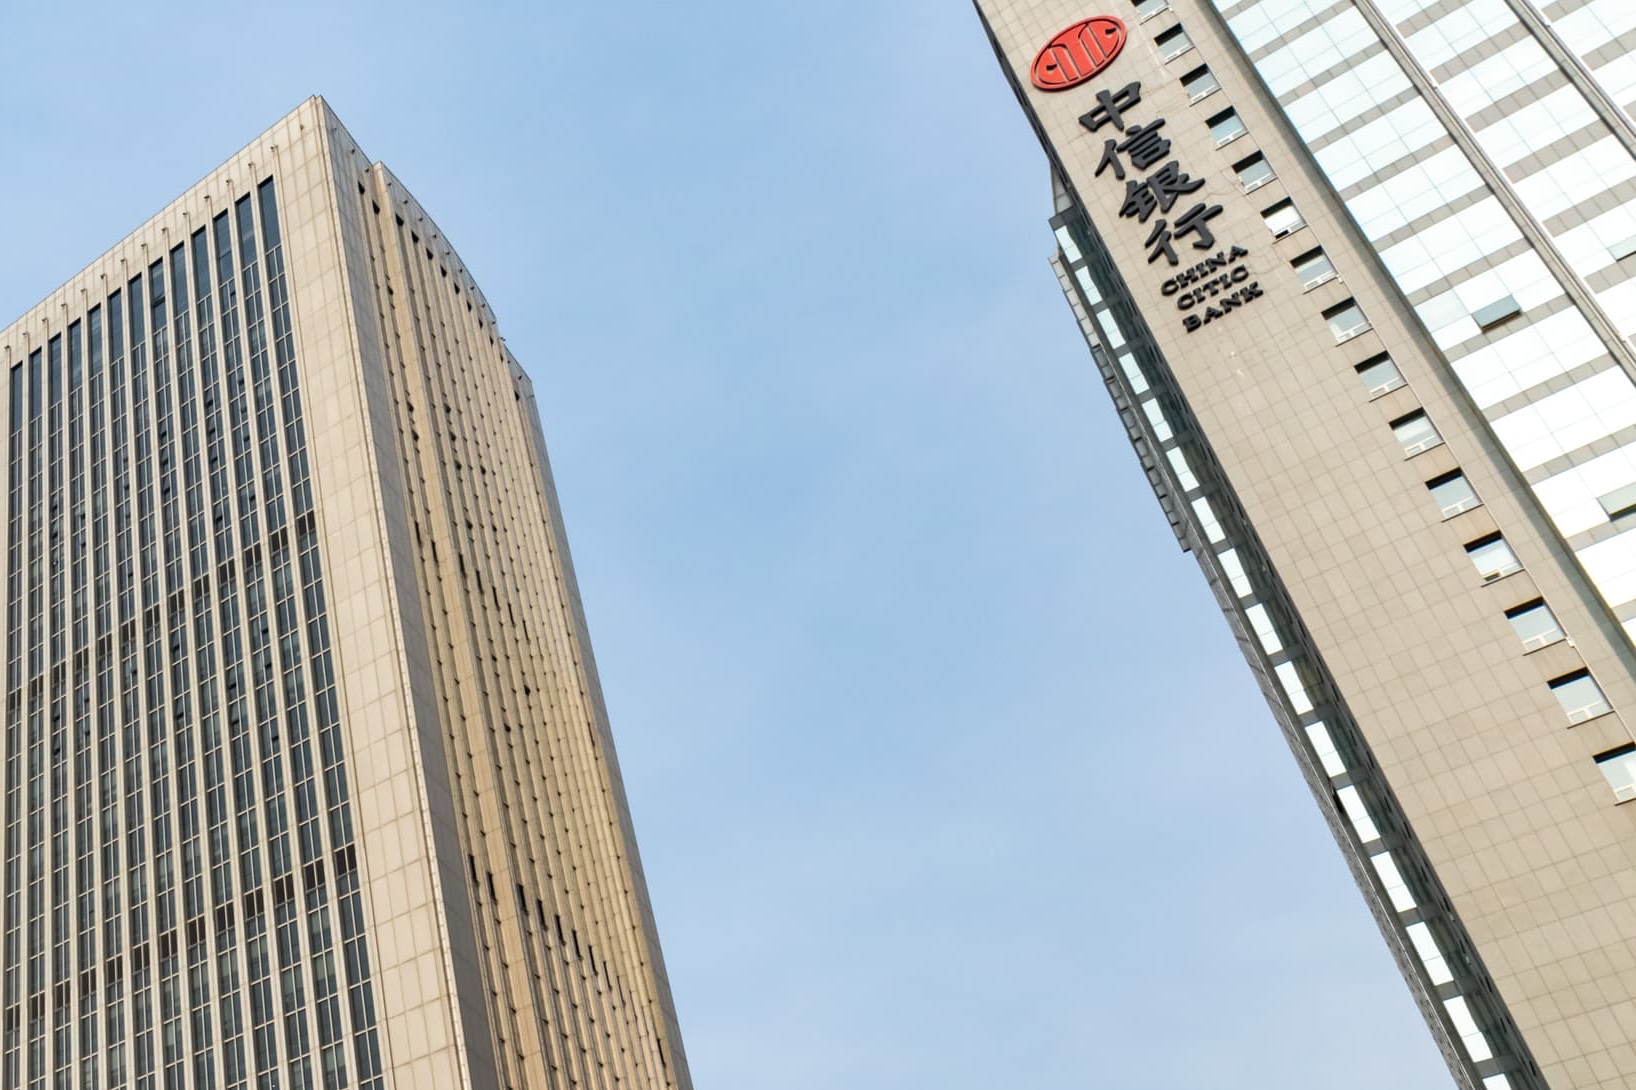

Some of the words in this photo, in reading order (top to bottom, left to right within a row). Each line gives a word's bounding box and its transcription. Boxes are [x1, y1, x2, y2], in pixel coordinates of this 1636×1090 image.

[1078, 81, 1223, 266] 中信银行
[1161, 245, 1249, 296] CHINA
[1177, 264, 1250, 310] CITIC
[1182, 281, 1264, 333] BANK
